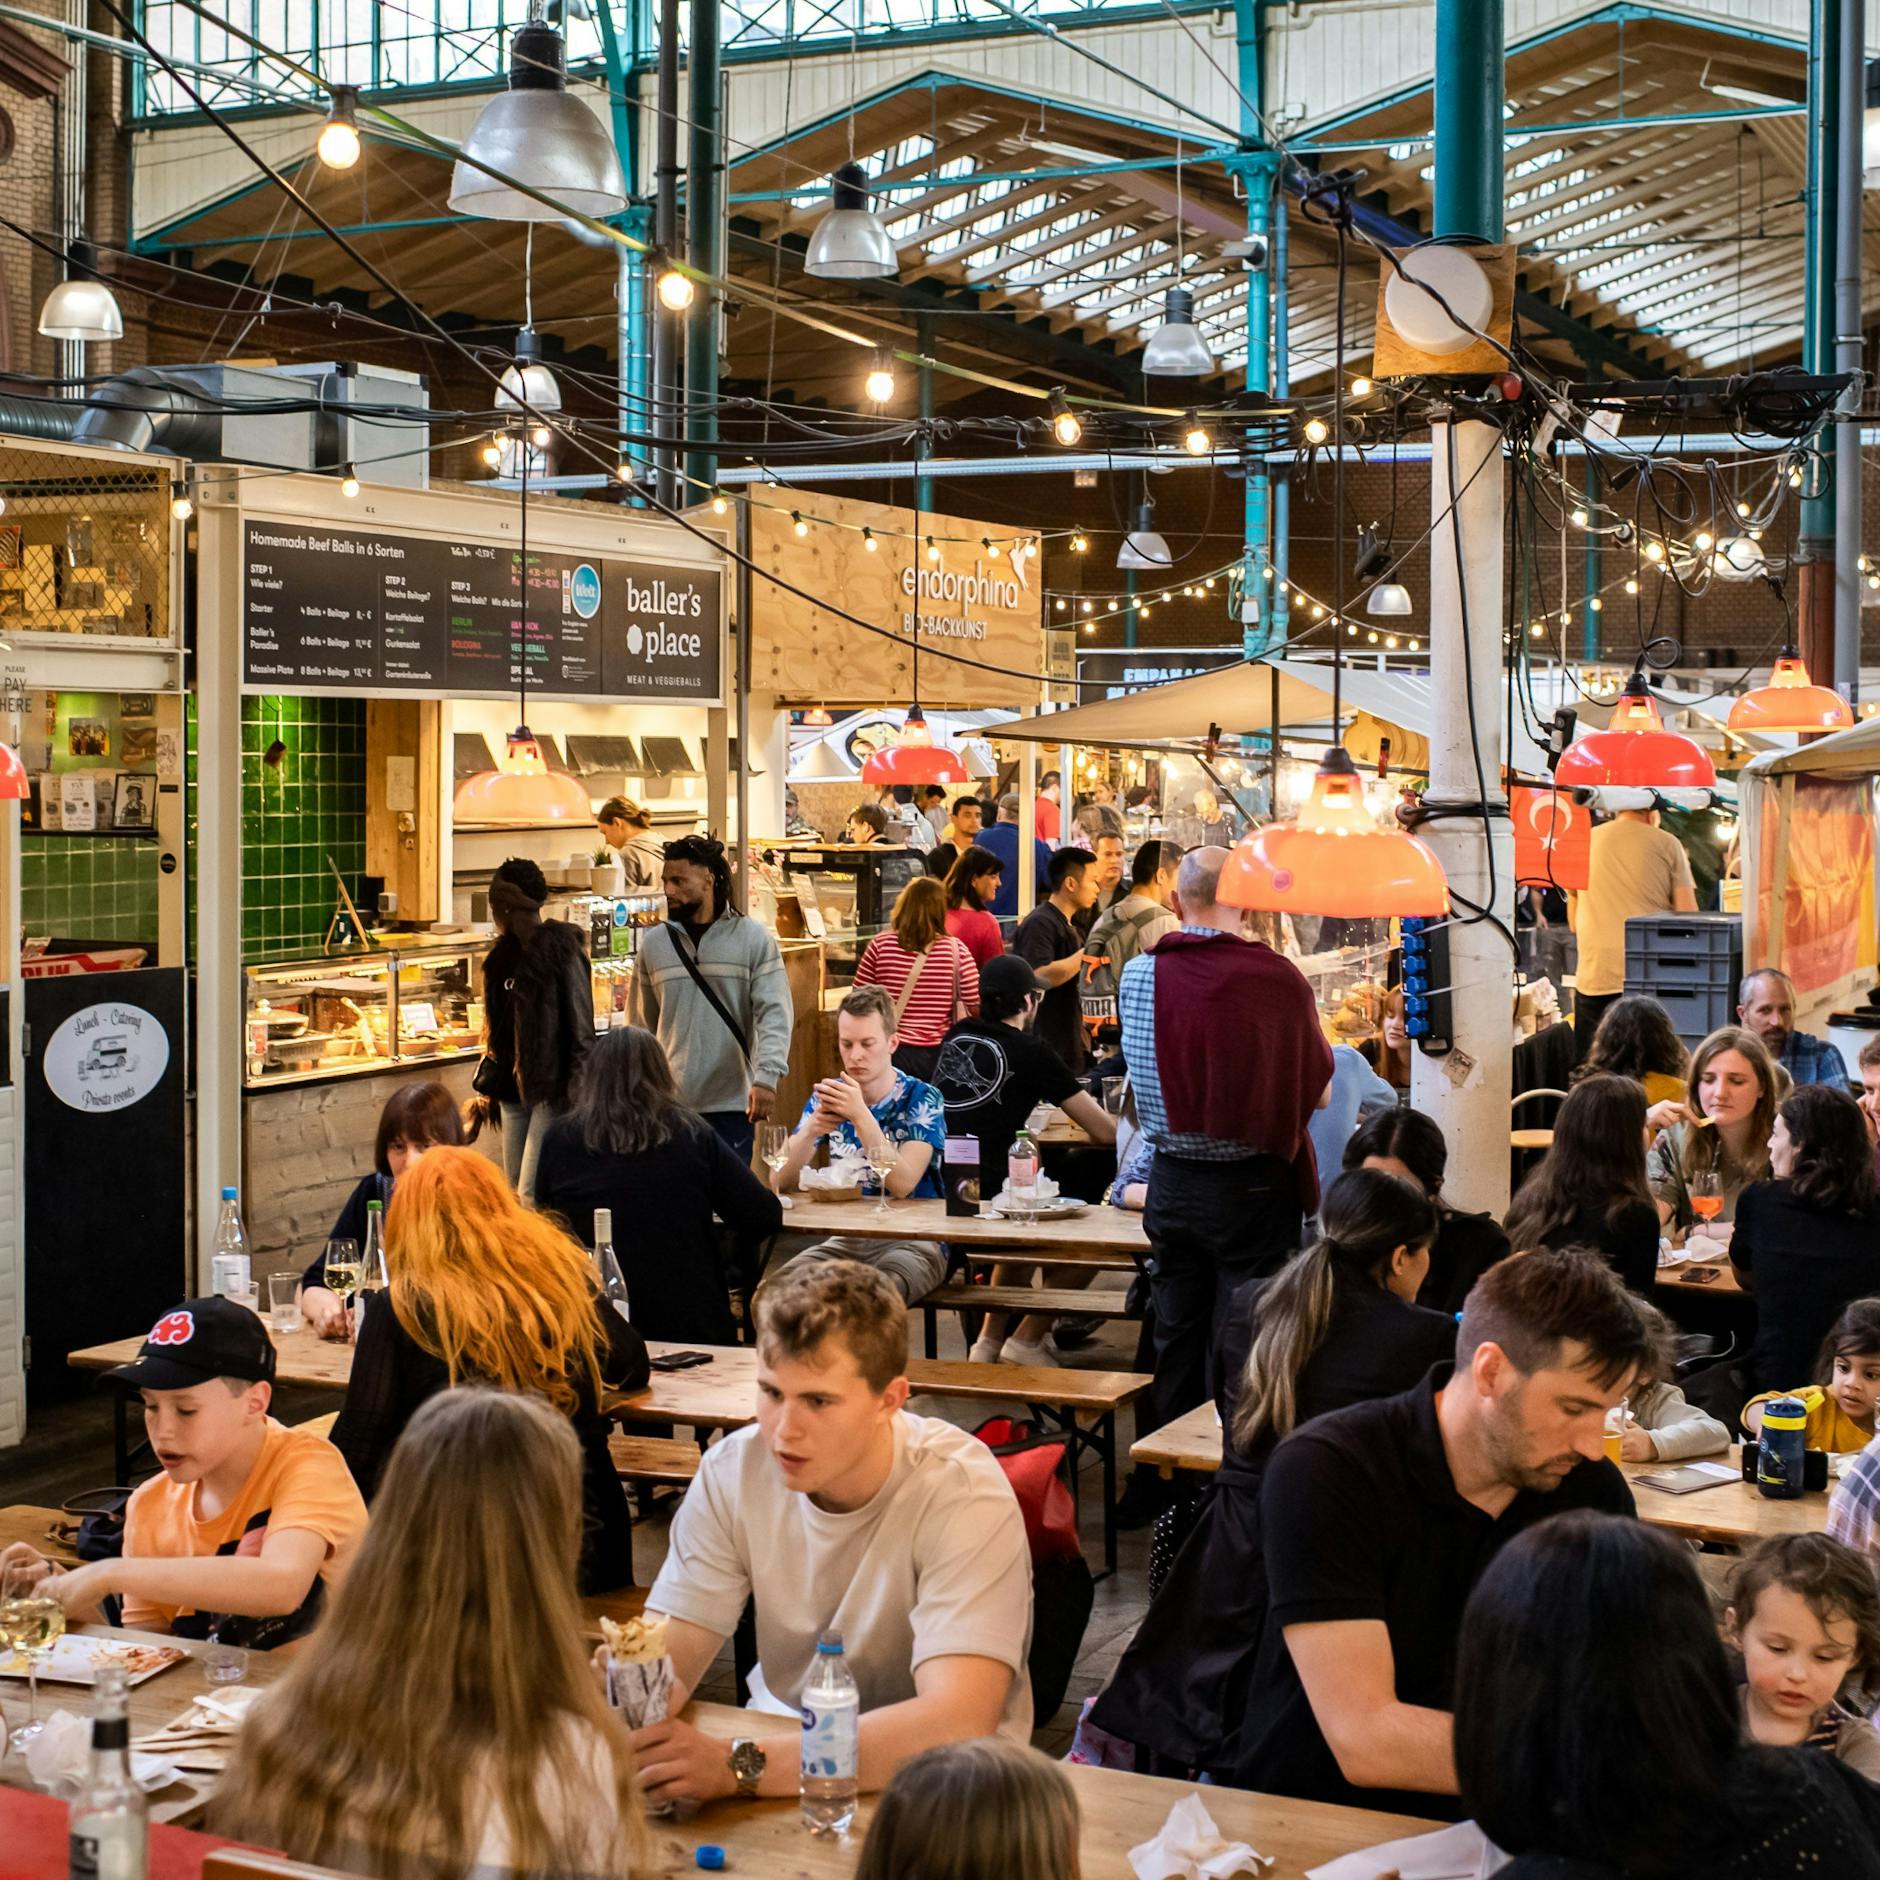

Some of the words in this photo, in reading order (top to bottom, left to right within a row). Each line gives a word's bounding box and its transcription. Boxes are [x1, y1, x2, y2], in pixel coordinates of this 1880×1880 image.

[250, 530, 307, 549] Homemade
[308, 536, 330, 551] Beef
[332, 539, 355, 554] Balls
[356, 541, 365, 555] in
[367, 543, 373, 556] 6
[375, 543, 405, 558] Sorten
[250, 564, 268, 574] STEP
[385, 575, 400, 585] STEP
[451, 581, 466, 591] STEP
[902, 554, 1018, 616] endorphina
[645, 621, 701, 663] place
[4, 677, 27, 692] PAY
[626, 675, 646, 685] MEAT
[655, 676, 702, 687] VEGGIEBALLS
[0, 697, 32, 713] HERE
[73, 1011, 99, 1036] Lunch
[110, 1008, 142, 1035] Catering
[81, 1090, 113, 1109] Private
[113, 1086, 135, 1104] events
